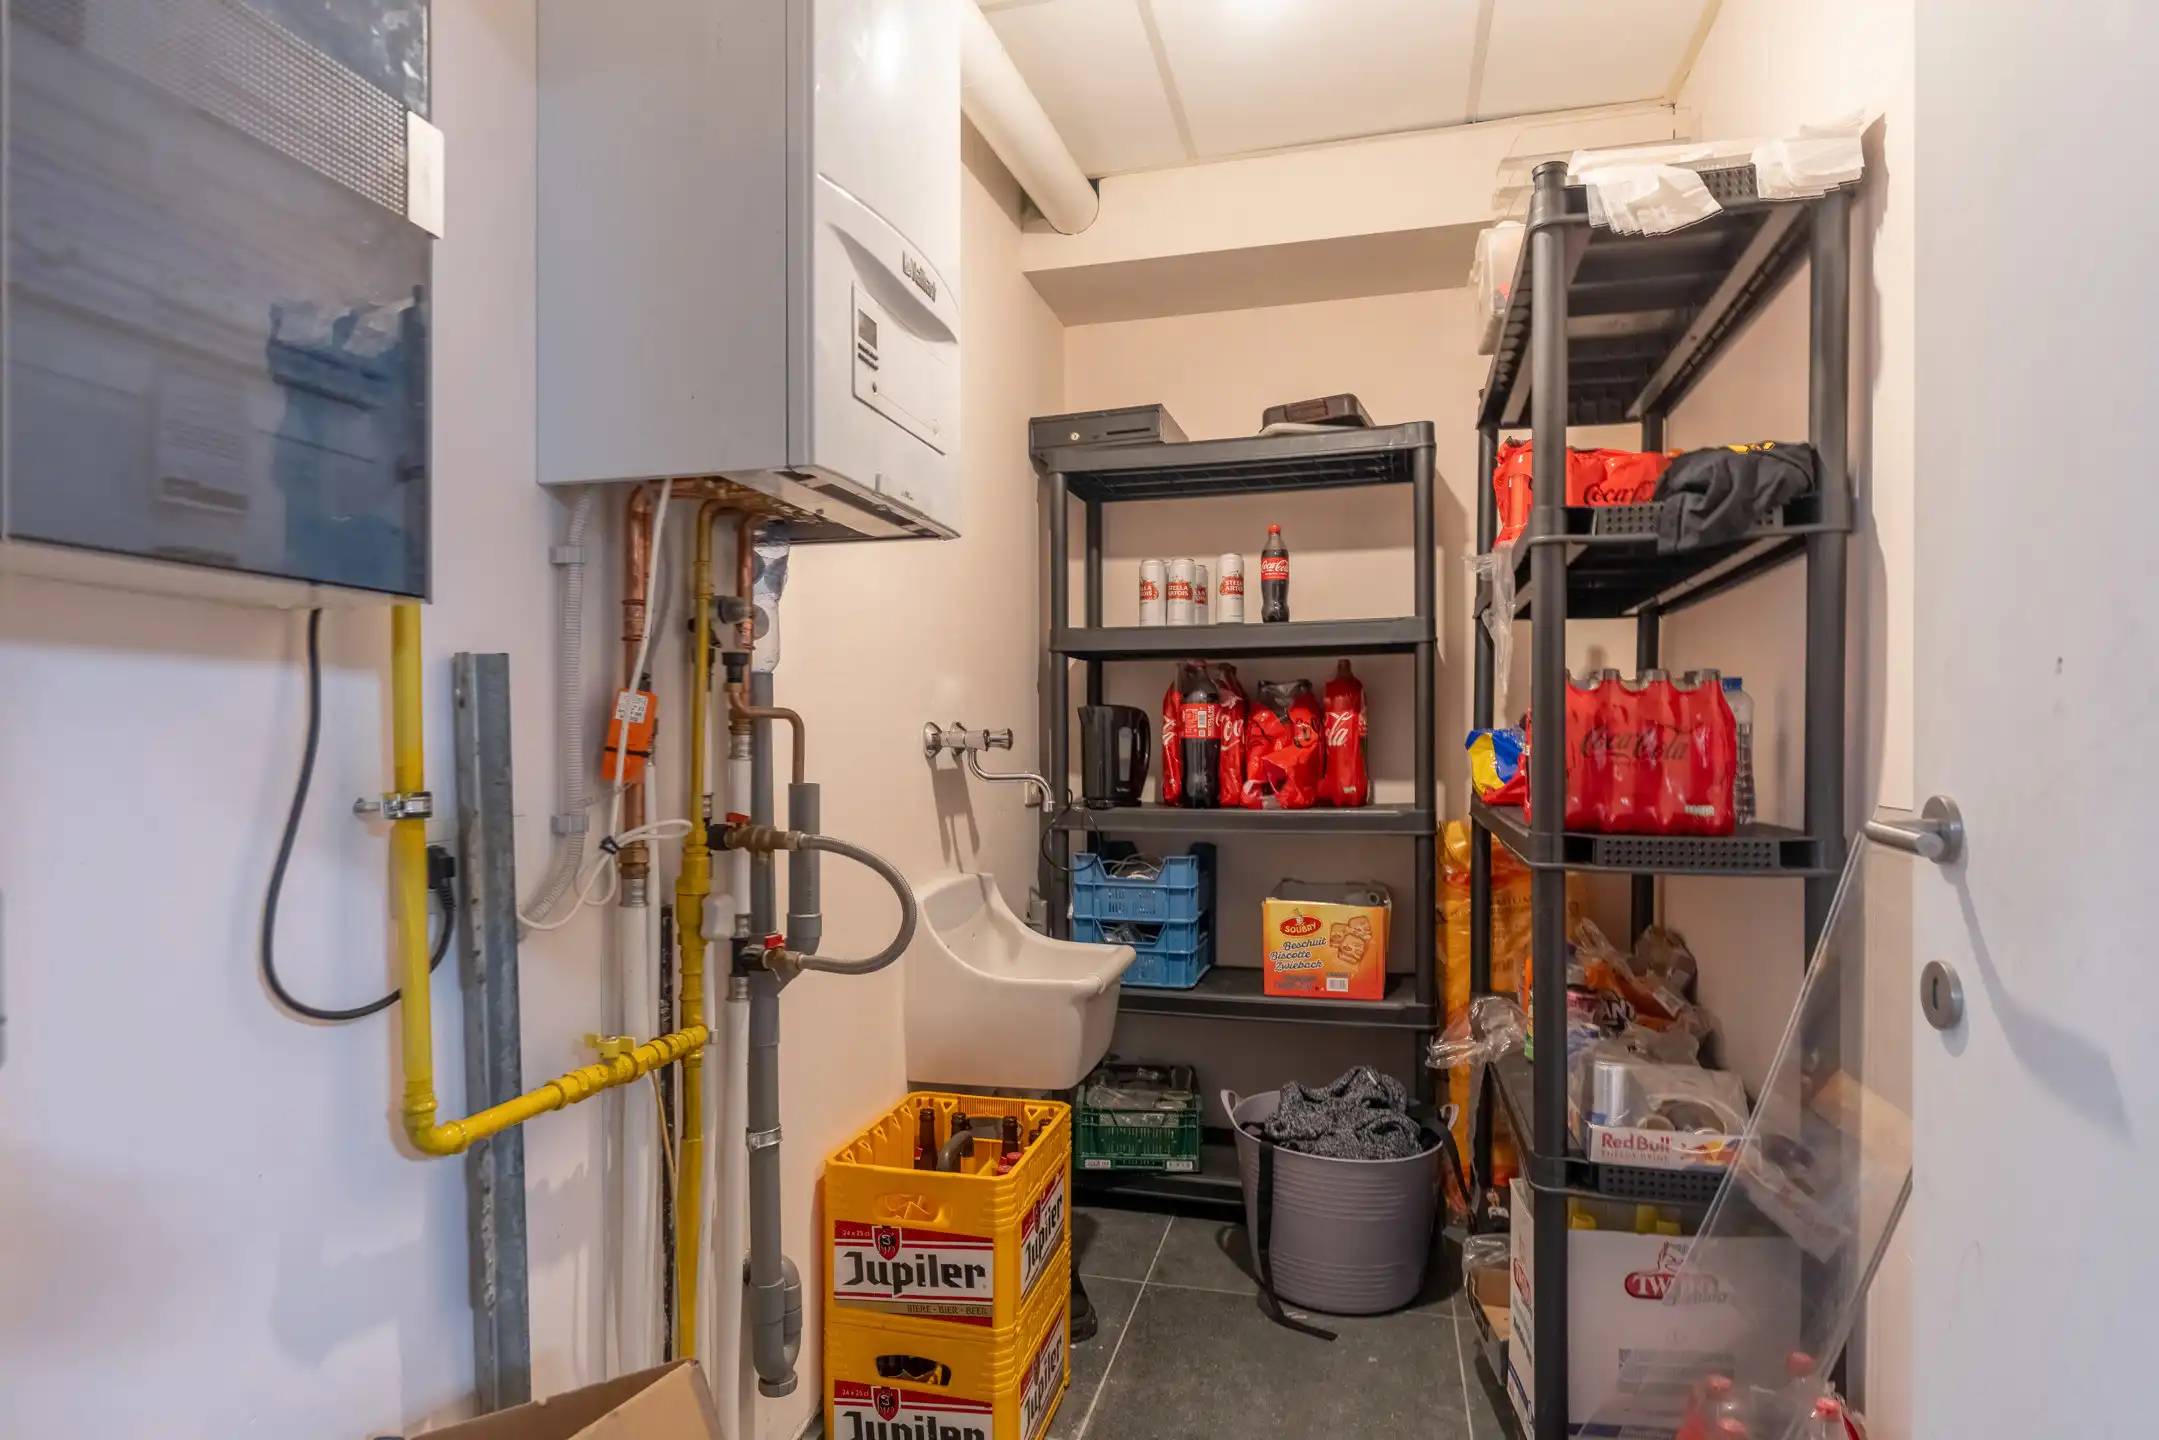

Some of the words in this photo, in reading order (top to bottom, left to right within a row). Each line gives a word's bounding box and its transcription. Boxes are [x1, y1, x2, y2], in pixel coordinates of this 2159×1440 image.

[1285, 922, 1316, 934] SOUBRY
[1282, 936, 1327, 951] Beschuit
[1269, 950, 1311, 961] Biscotte
[1275, 960, 1323, 972] Zwieback
[1602, 1132, 1634, 1149] Red
[1637, 1135, 1671, 1153] Bull
[1025, 1194, 1063, 1281] Jupiler
[842, 1251, 986, 1295] Jupiler
[938, 1305, 959, 1314] BIER
[966, 1306, 988, 1315] BEER
[1024, 1335, 1062, 1437] Jupiler
